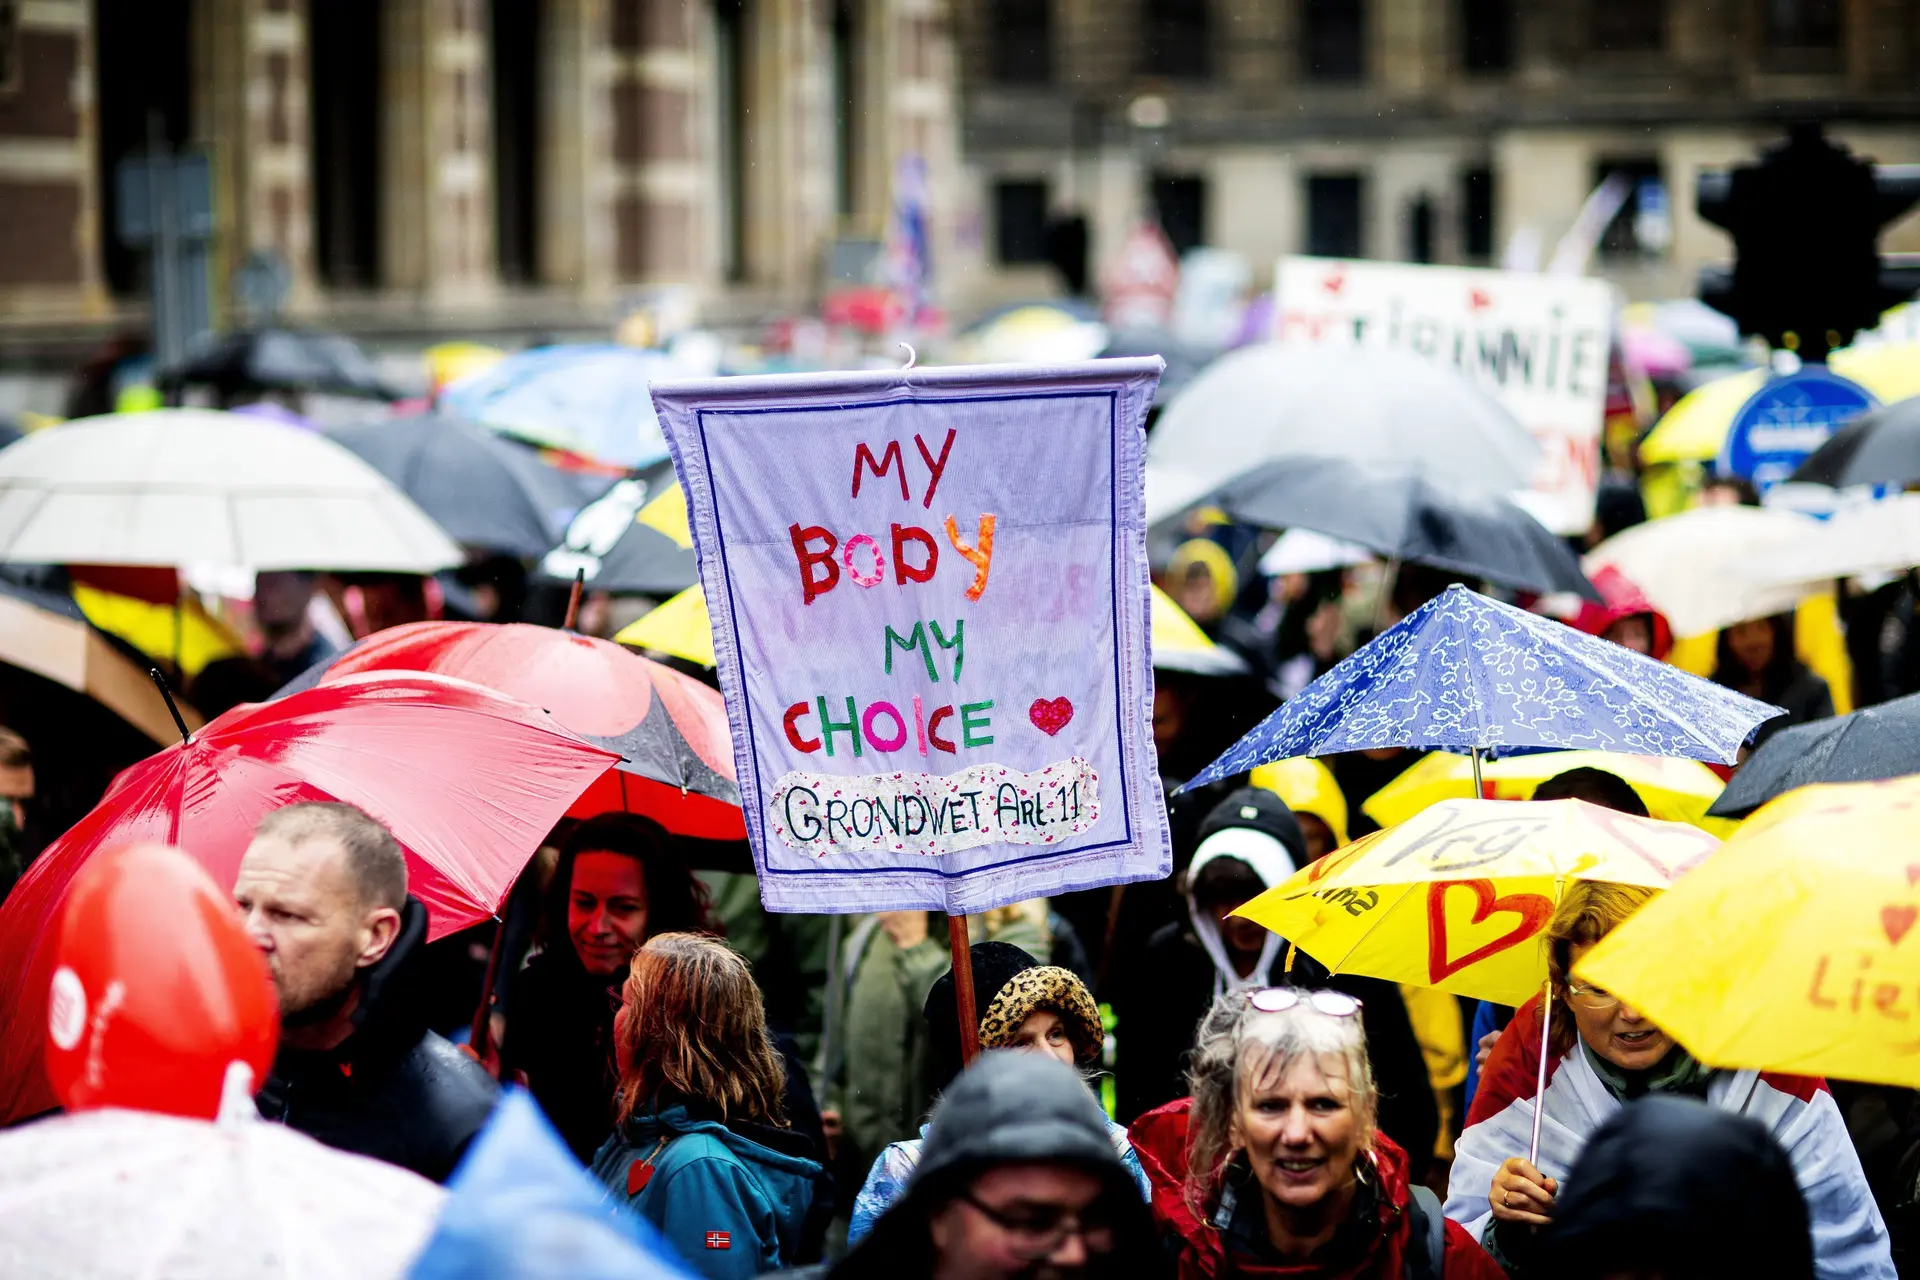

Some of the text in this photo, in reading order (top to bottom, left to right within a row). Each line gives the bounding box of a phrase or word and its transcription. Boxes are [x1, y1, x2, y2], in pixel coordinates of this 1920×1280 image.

[852, 428, 957, 509] MY
[788, 512, 996, 605] BODY
[884, 619, 964, 684] MY
[783, 696, 995, 757] CHOICE
[785, 785, 983, 842] GRONDWET
